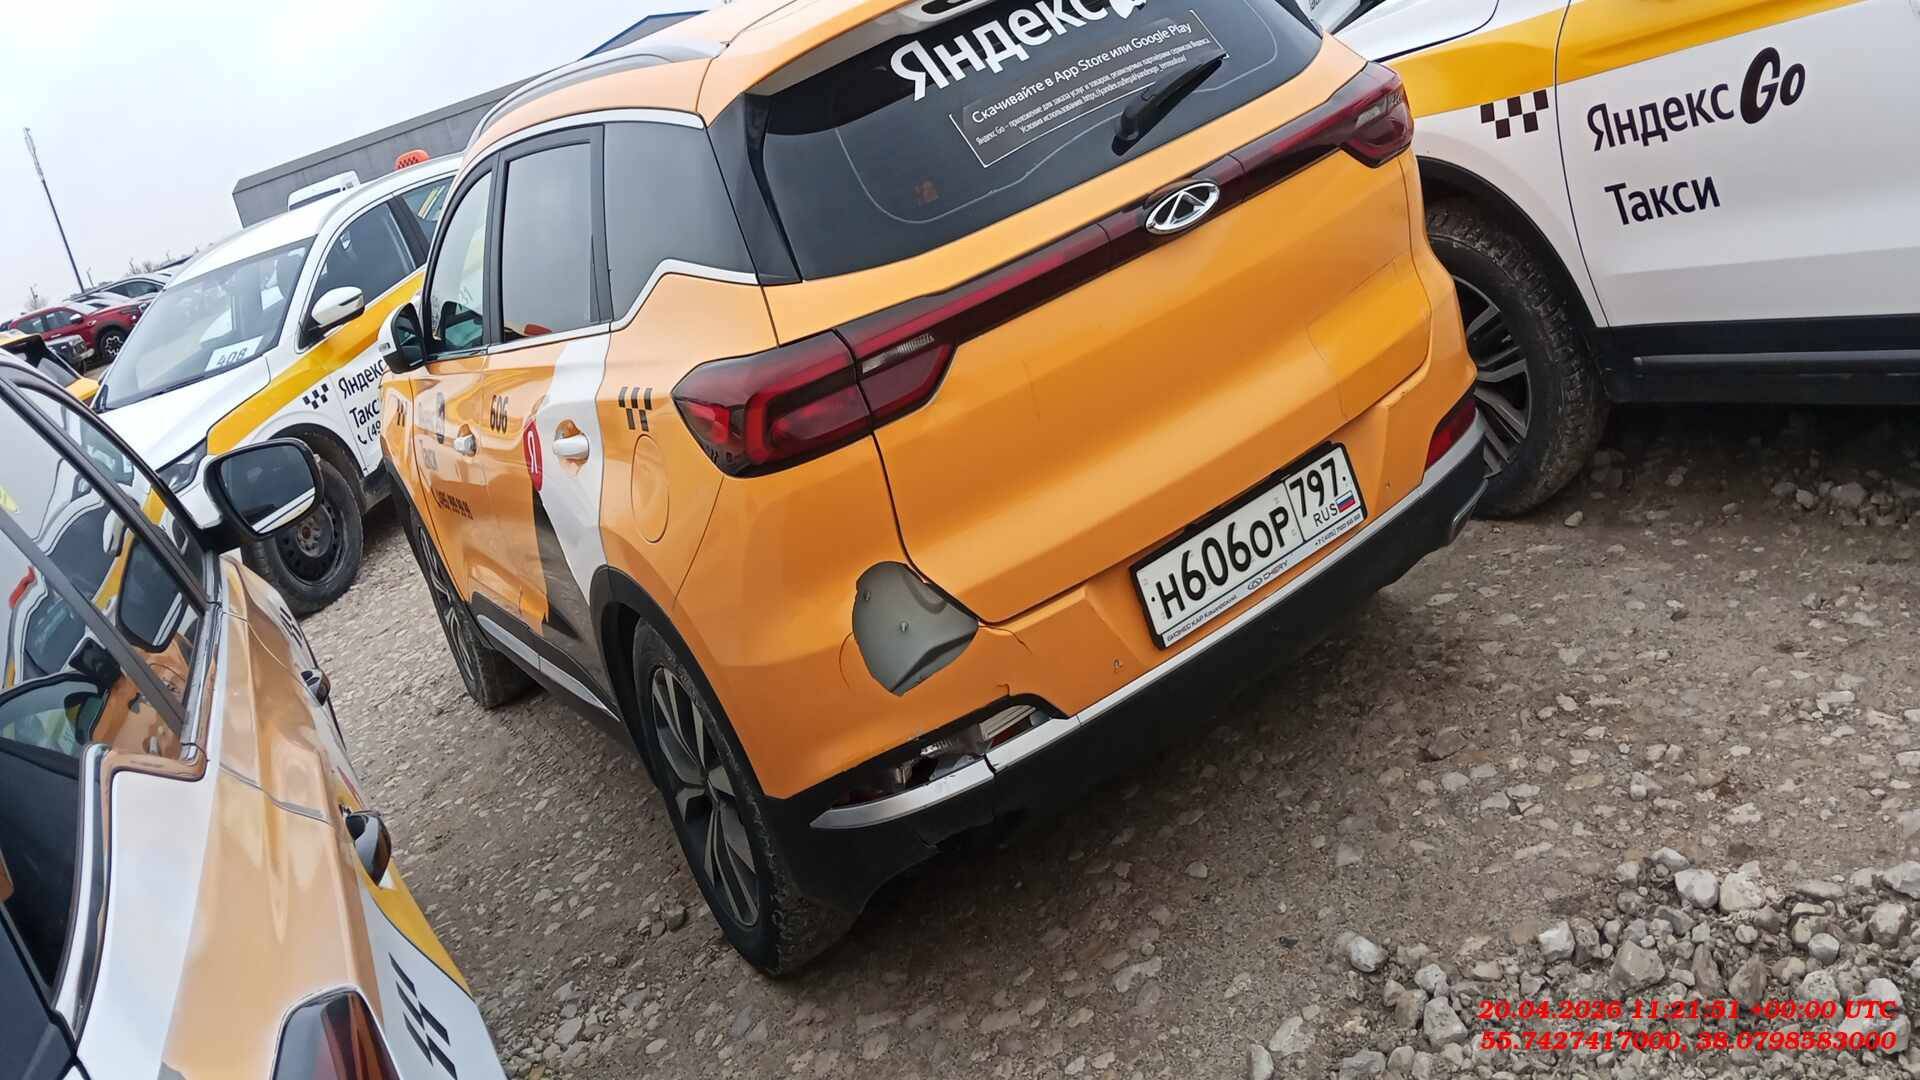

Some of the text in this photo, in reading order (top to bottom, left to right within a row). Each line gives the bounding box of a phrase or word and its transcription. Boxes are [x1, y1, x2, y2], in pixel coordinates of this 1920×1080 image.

[971, 81, 1046, 124] Скачивайте
[1045, 78, 1055, 87] в
[1053, 61, 1079, 84] App
[1078, 52, 1110, 72] Store
[1109, 44, 1132, 58] или
[1131, 30, 1170, 49] Google
[1167, 23, 1192, 36] Play
[1587, 46, 1806, 152] Яндекс Go
[1604, 175, 1721, 226] Такси
[338, 359, 384, 399] Яндекс
[349, 399, 380, 429] Такс
[490, 395, 508, 434] 606
[1289, 457, 1339, 518] 797
[1313, 503, 1338, 527] RUS
